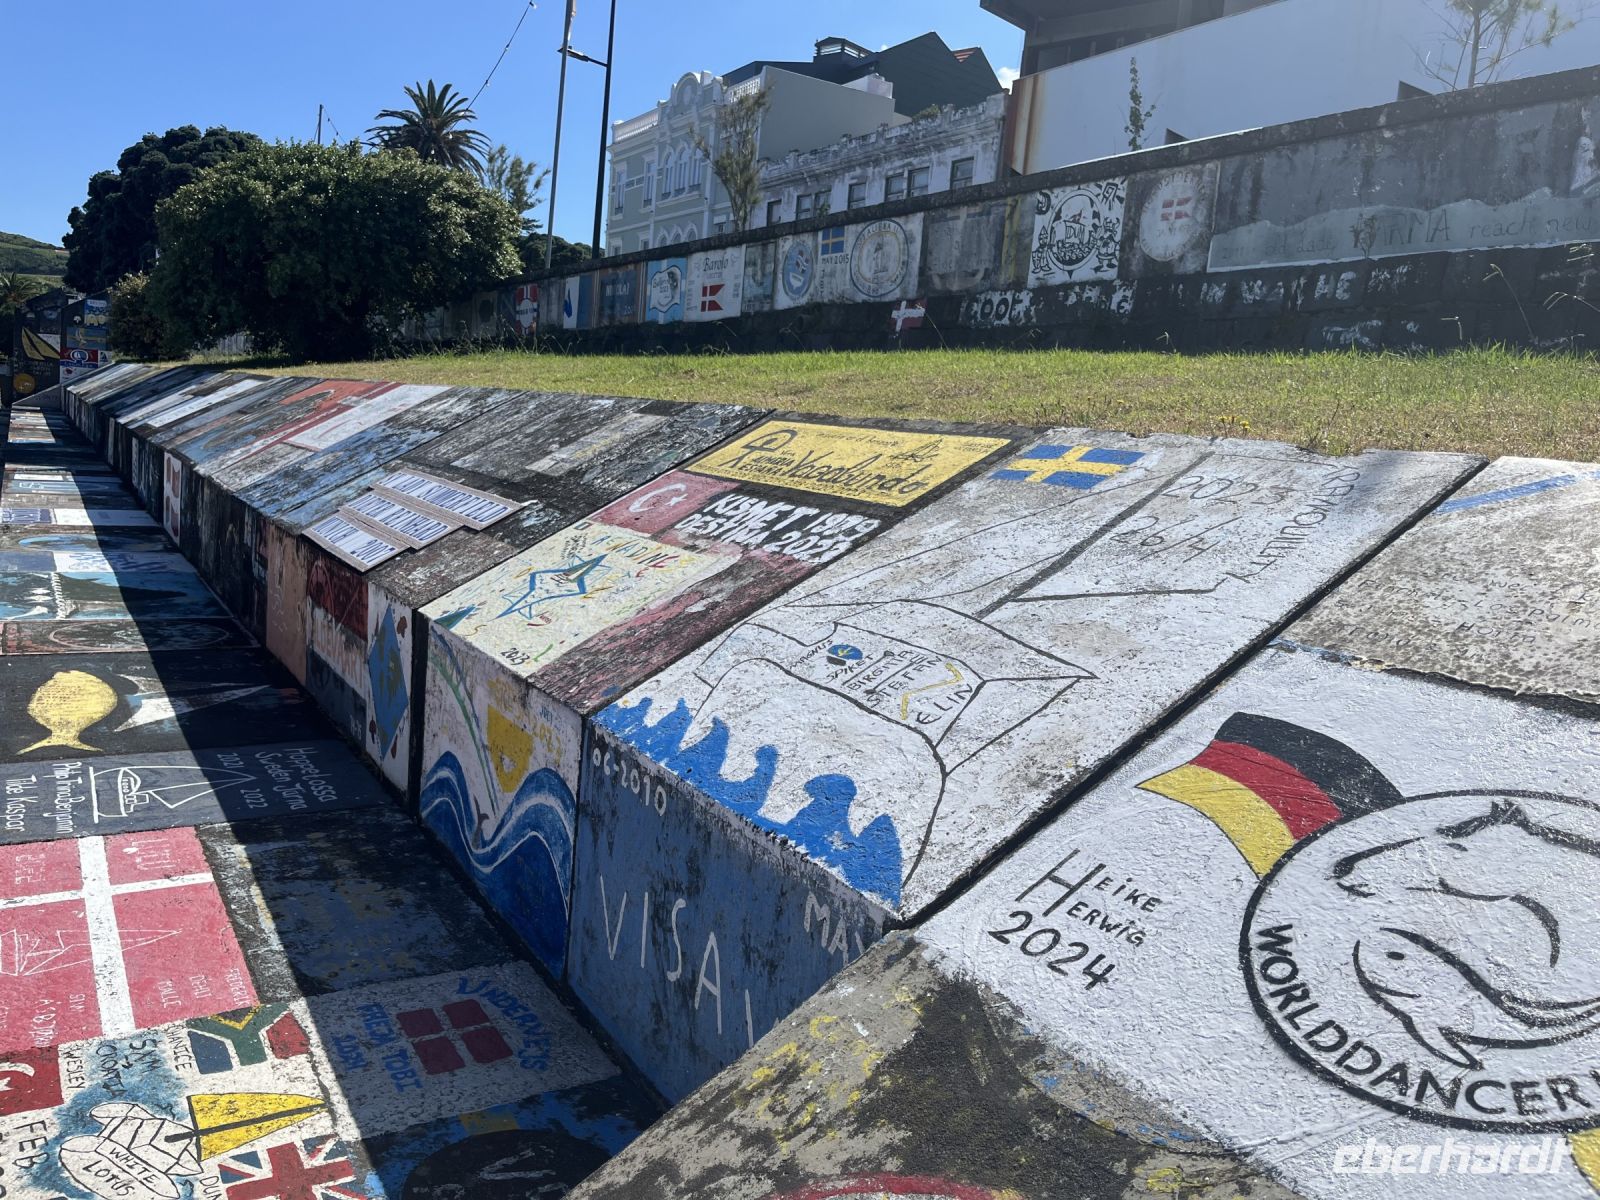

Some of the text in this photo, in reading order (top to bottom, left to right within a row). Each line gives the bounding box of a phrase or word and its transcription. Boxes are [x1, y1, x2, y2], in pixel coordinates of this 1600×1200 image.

[821, 256, 833, 265] MAY
[377, 507, 450, 540] REINHARD
[703, 493, 820, 532] KISMET
[347, 538, 396, 563] 2007
[825, 652, 875, 684] SPIKET
[867, 655, 944, 709] STEFAN
[914, 682, 975, 725] ELIN
[216, 752, 245, 771] 2021
[254, 750, 291, 784] Sweden
[284, 746, 339, 803] Hoppetossa
[6, 774, 37, 796] Tilde
[239, 788, 269, 809] 2022
[1, 795, 39, 833] Kaspar
[43, 795, 86, 834] Benjamin
[987, 910, 1117, 992] 2024
[1254, 923, 1594, 1118] WORLDDANCER
[59, 1046, 85, 1091] WESLEY
[96, 1043, 128, 1098] CROATIA
[382, 1048, 424, 1093] TOBI
[14, 1120, 50, 1170] FEB
[82, 1159, 135, 1197] LOTUS
[109, 1145, 157, 1186] WHITE
